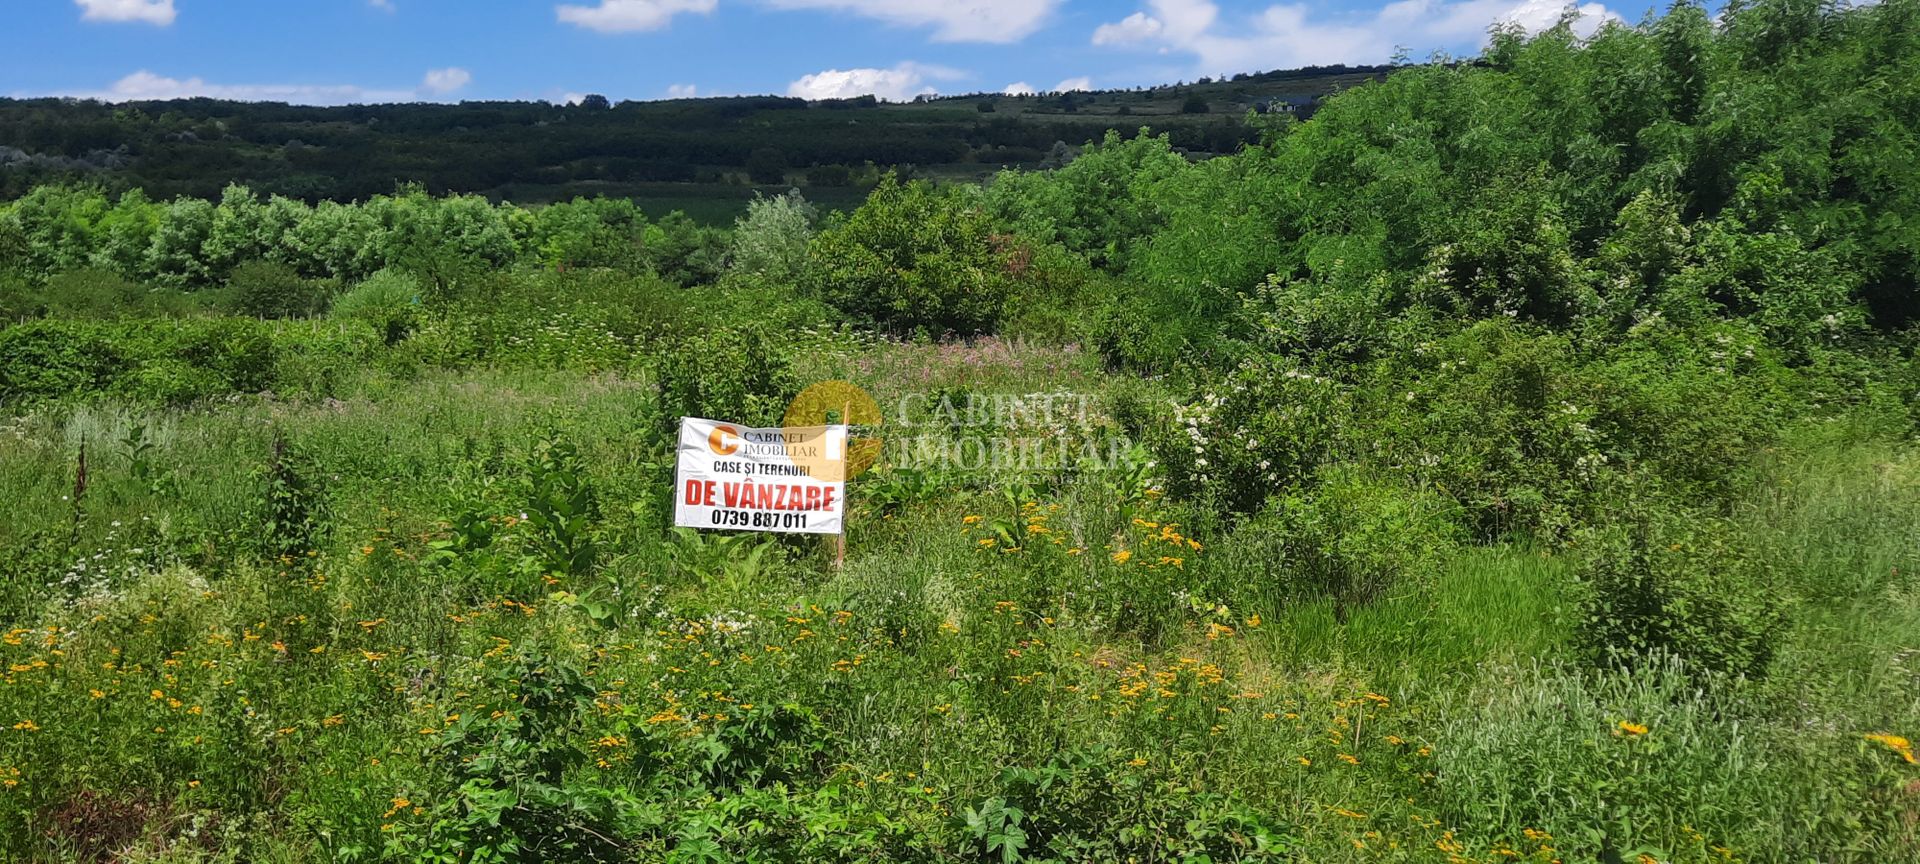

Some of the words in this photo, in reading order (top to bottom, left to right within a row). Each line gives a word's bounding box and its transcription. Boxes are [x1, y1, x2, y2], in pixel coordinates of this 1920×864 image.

[743, 431, 807, 443] CABINET
[744, 444, 817, 457] IMOBILIAR
[713, 460, 741, 474] CASE
[759, 463, 811, 477] TERENURI
[685, 479, 716, 506] DE
[723, 478, 835, 512] VÂNZARE
[711, 509, 748, 526] 0739
[753, 511, 779, 528] 887
[783, 513, 807, 528] 011
